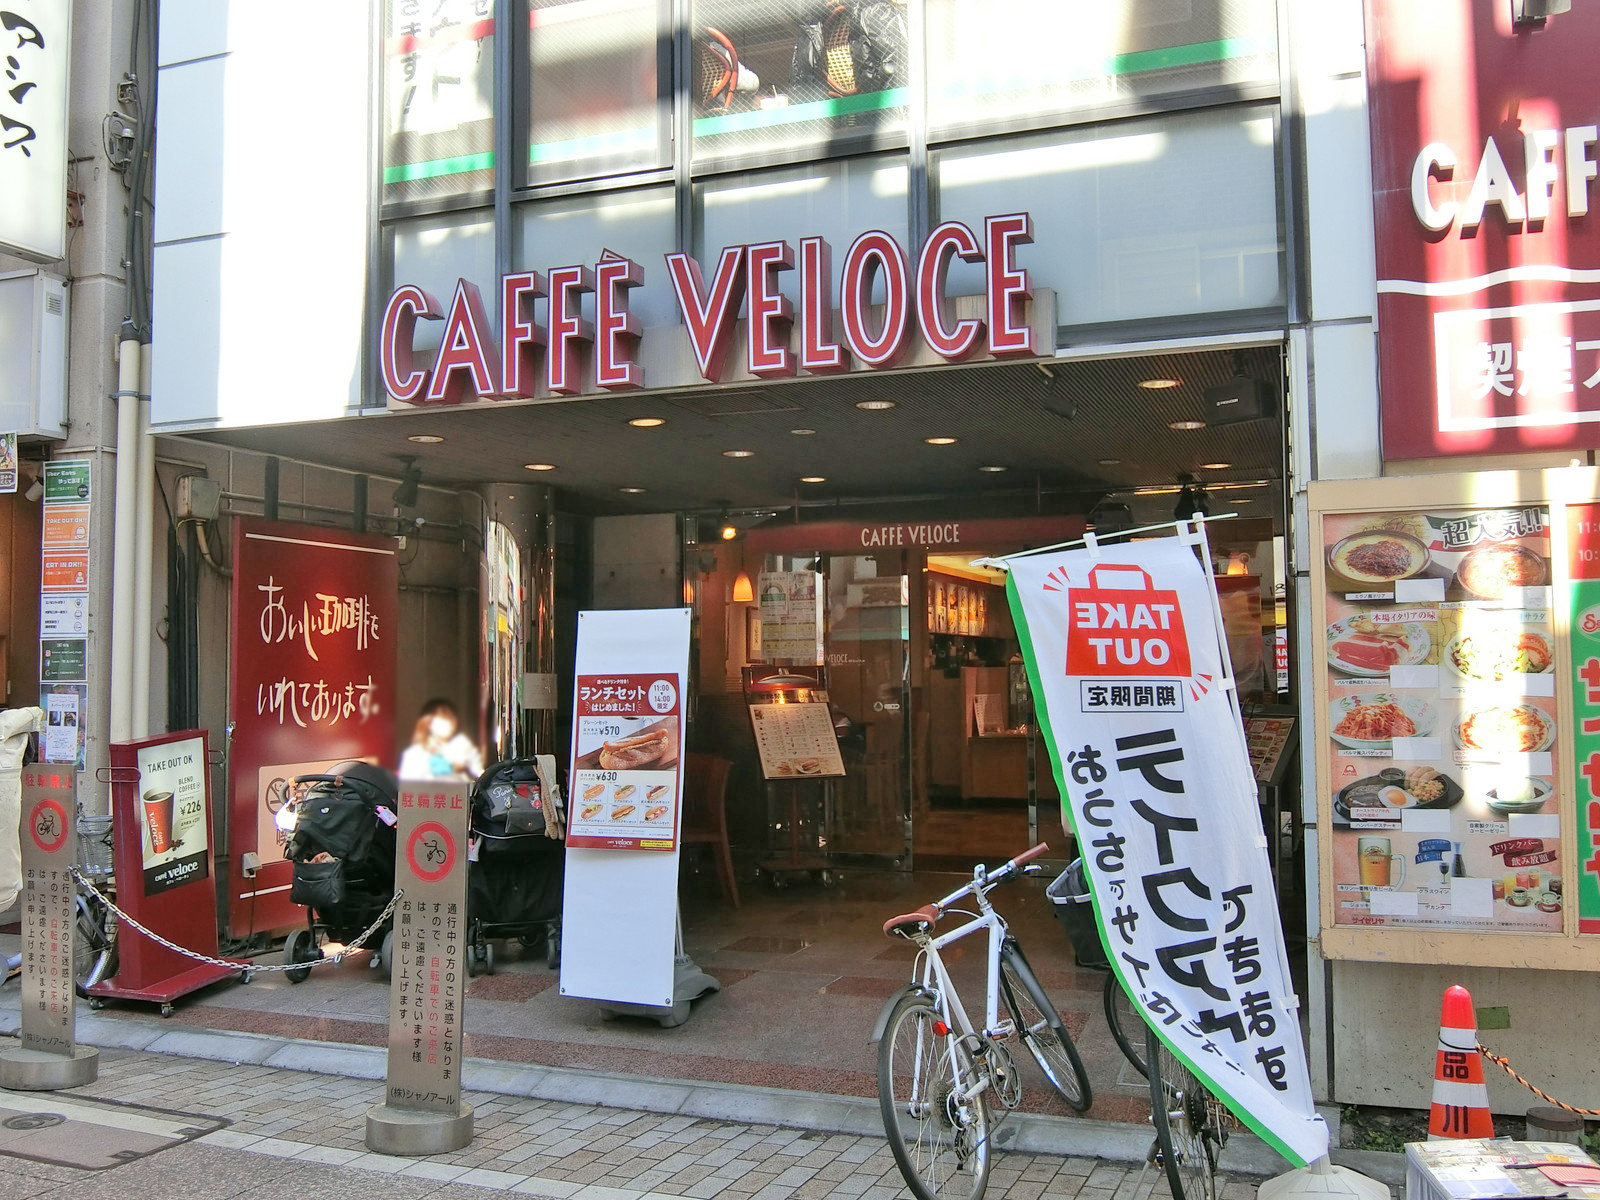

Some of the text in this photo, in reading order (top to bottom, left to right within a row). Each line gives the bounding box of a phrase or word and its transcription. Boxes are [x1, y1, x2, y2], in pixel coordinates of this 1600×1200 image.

[664, 212, 1034, 382] VELOCE
[907, 523, 960, 545] VELOCE
[1442, 508, 1544, 549] 超人気!!
[1577, 522, 1600, 534] 11:
[257, 575, 380, 662] おいしい珈琲を
[1373, 610, 1437, 622] 本場イタリアの味
[580, 686, 646, 701] ランチセット
[653, 684, 670, 692] 11:00
[591, 702, 636, 712] はじめました!
[599, 725, 620, 736] ¥570
[147, 754, 194, 774] TAKE OUT OK
[178, 775, 194, 785] BLEND
[596, 771, 617, 782] ¥630
[178, 783, 196, 793] COFFEE
[180, 800, 202, 816] ¥226
[401, 793, 463, 809] 駐輪禁止
[150, 812, 159, 846] veloce
[615, 838, 633, 846] veloce
[1492, 839, 1539, 852] ドリンクバー
[1511, 855, 1550, 867] 飲み放題
[167, 861, 199, 879] veloce
[1352, 917, 1385, 925] サイゼリヤ
[399, 900, 412, 1028] お願い申し上げます。
[412, 901, 426, 1063] は、ご遠慮くださいます様
[427, 902, 442, 1065] すので、自転車でのご来店
[442, 903, 457, 1080] 通行中の方のご迷惑となりま
[1442, 1051, 1469, 1134] 品川
